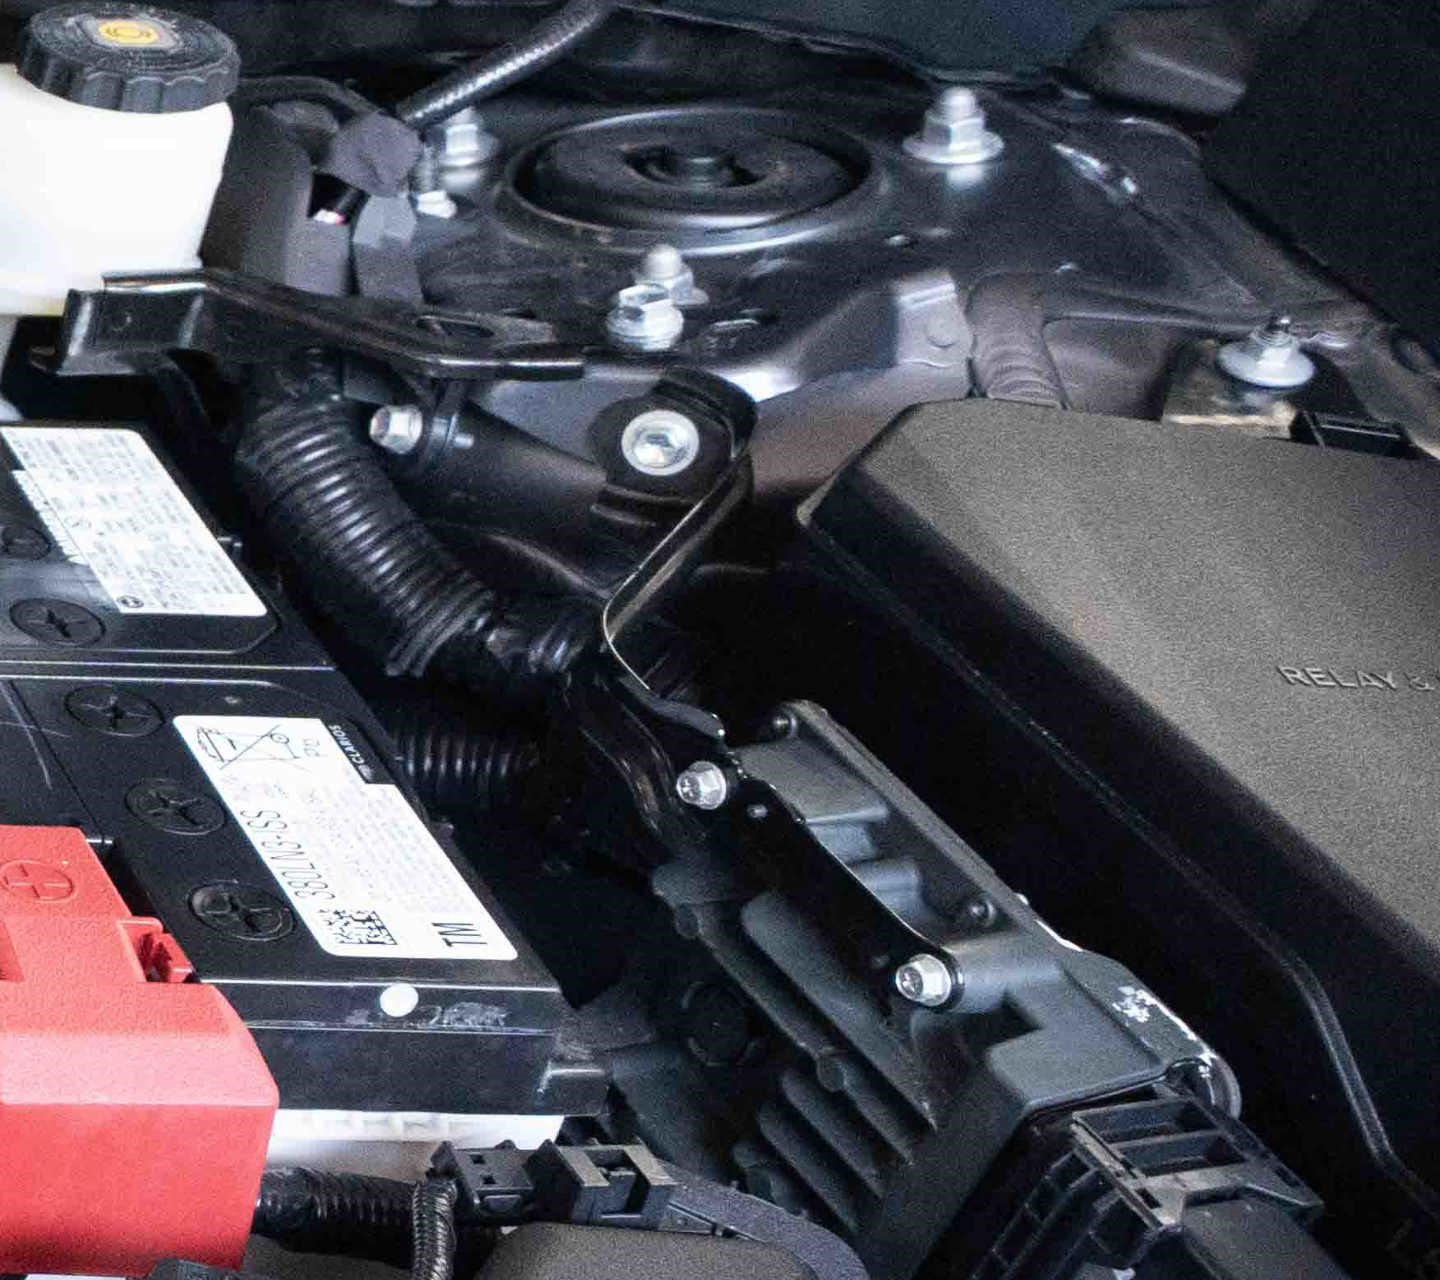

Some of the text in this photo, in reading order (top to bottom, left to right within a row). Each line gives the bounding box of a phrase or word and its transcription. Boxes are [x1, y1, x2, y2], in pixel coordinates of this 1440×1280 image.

[1276, 665, 1397, 690] RELAY
[328, 724, 366, 765] CLARIOS
[431, 922, 488, 948] TM
